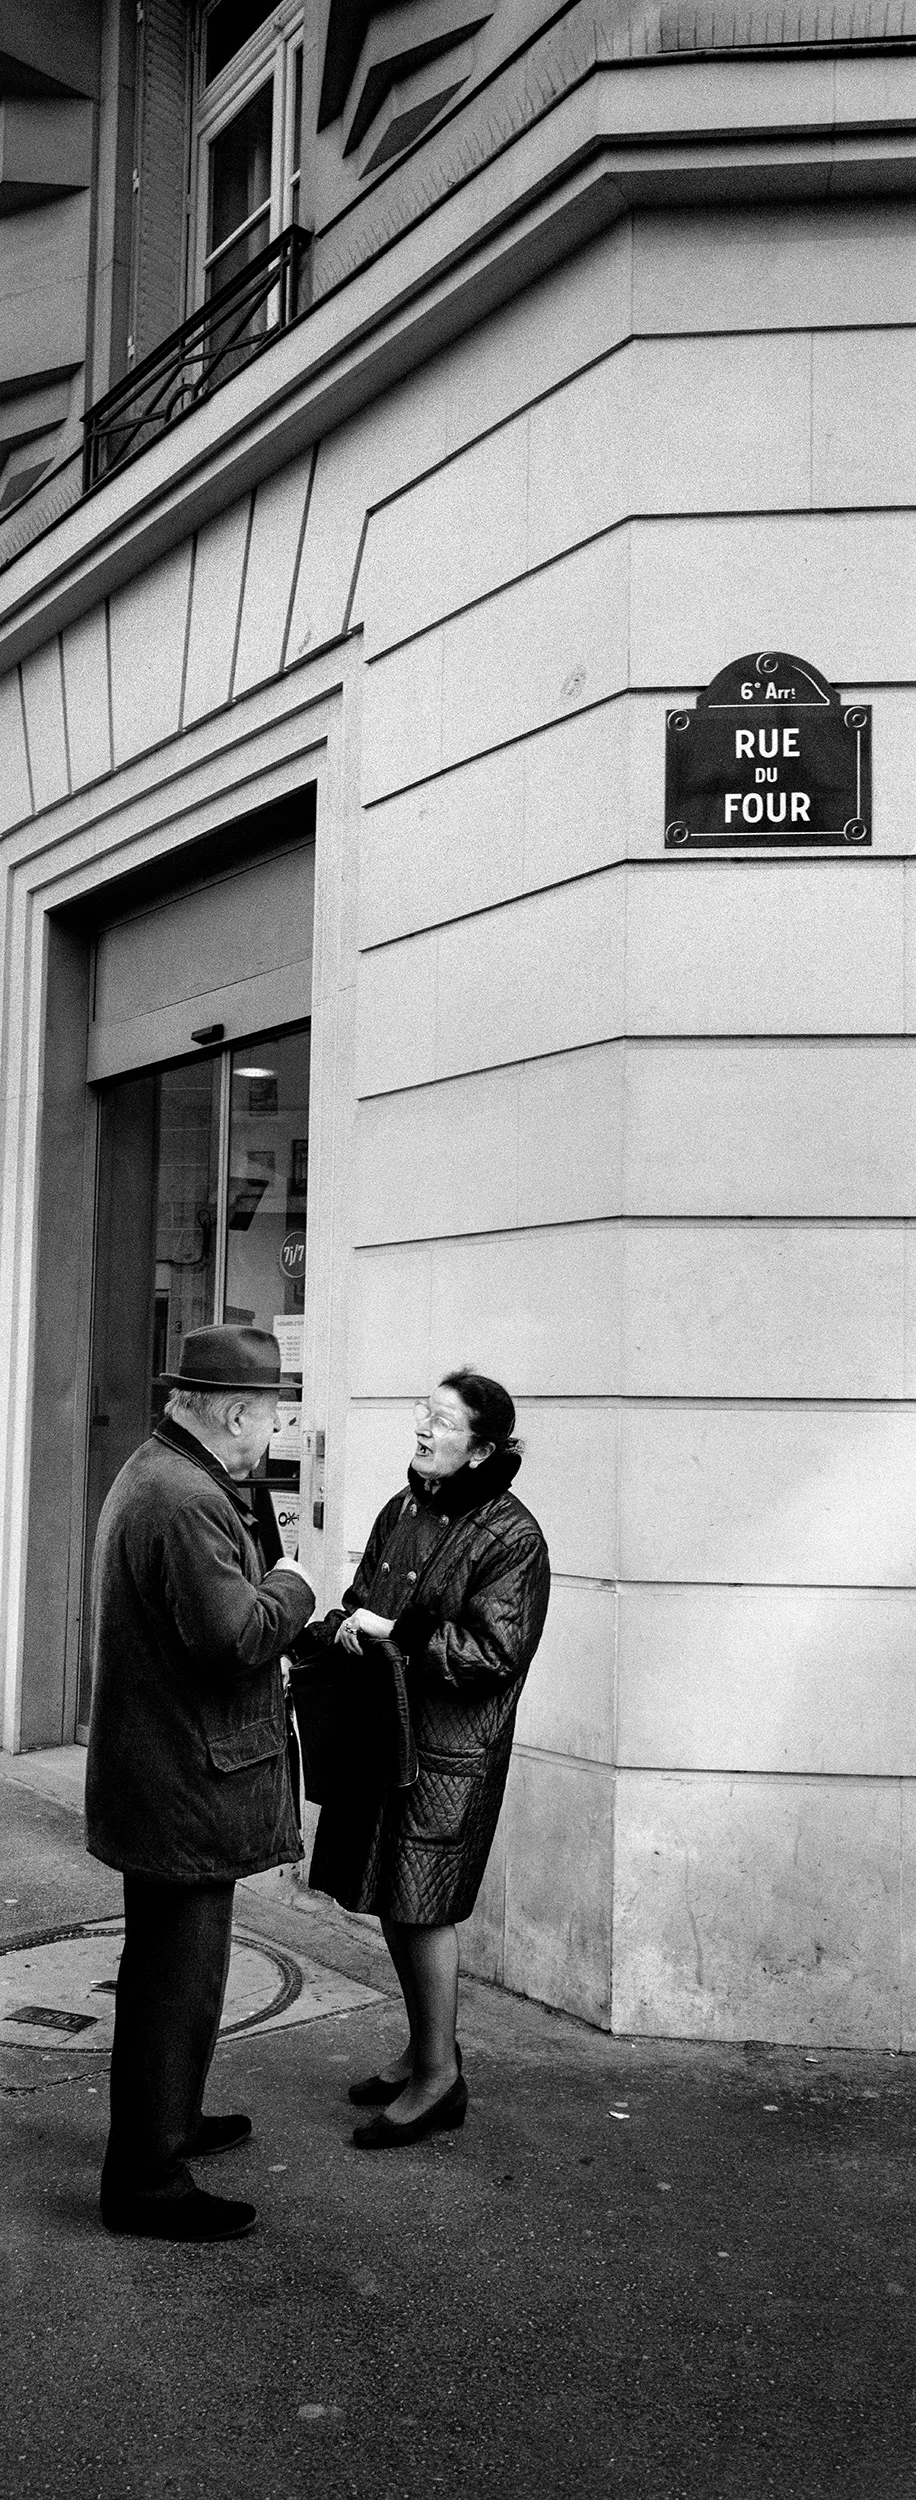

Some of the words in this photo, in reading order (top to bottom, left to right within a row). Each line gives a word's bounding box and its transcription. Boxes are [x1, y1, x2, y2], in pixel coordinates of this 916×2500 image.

[735, 728, 801, 759] RUE
[755, 767, 778, 783] DU
[724, 791, 811, 824] FOUR
[284, 1244, 305, 1266] 7j/7
